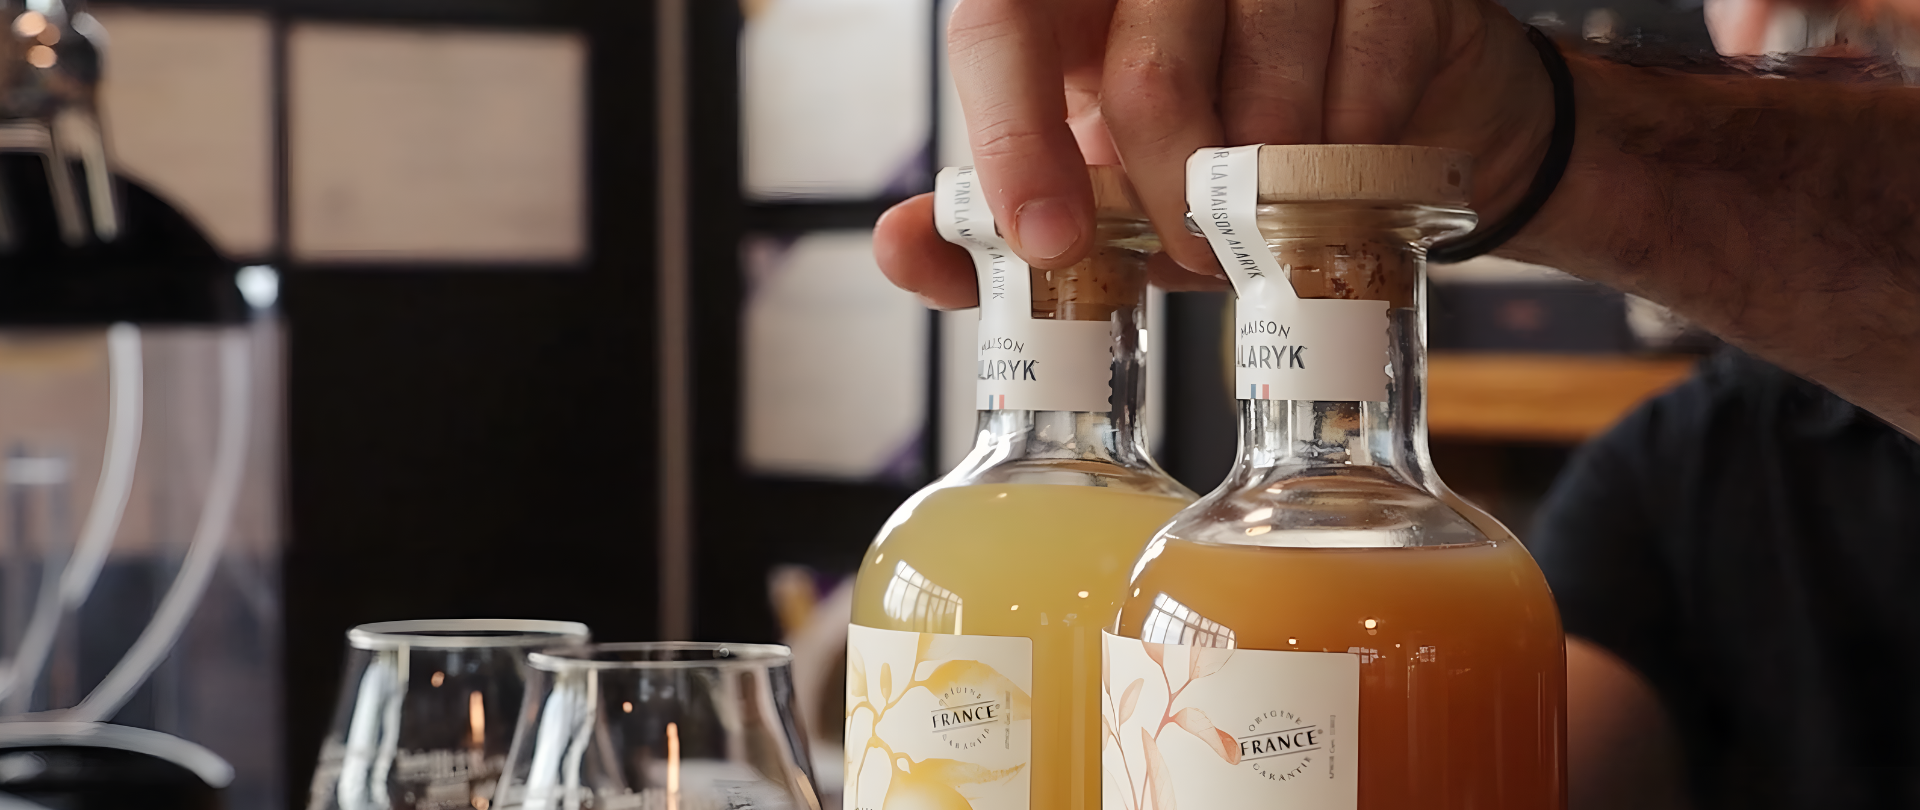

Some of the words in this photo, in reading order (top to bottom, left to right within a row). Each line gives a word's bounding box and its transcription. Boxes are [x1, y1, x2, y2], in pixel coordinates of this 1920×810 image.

[1210, 164, 1229, 181] LA
[954, 181, 971, 205] PAR
[954, 208, 971, 225] LA
[1210, 186, 1236, 236] MAISON
[1225, 238, 1266, 279] ALARYK
[988, 253, 1006, 300] ALARYK
[1240, 320, 1291, 340] MAISON
